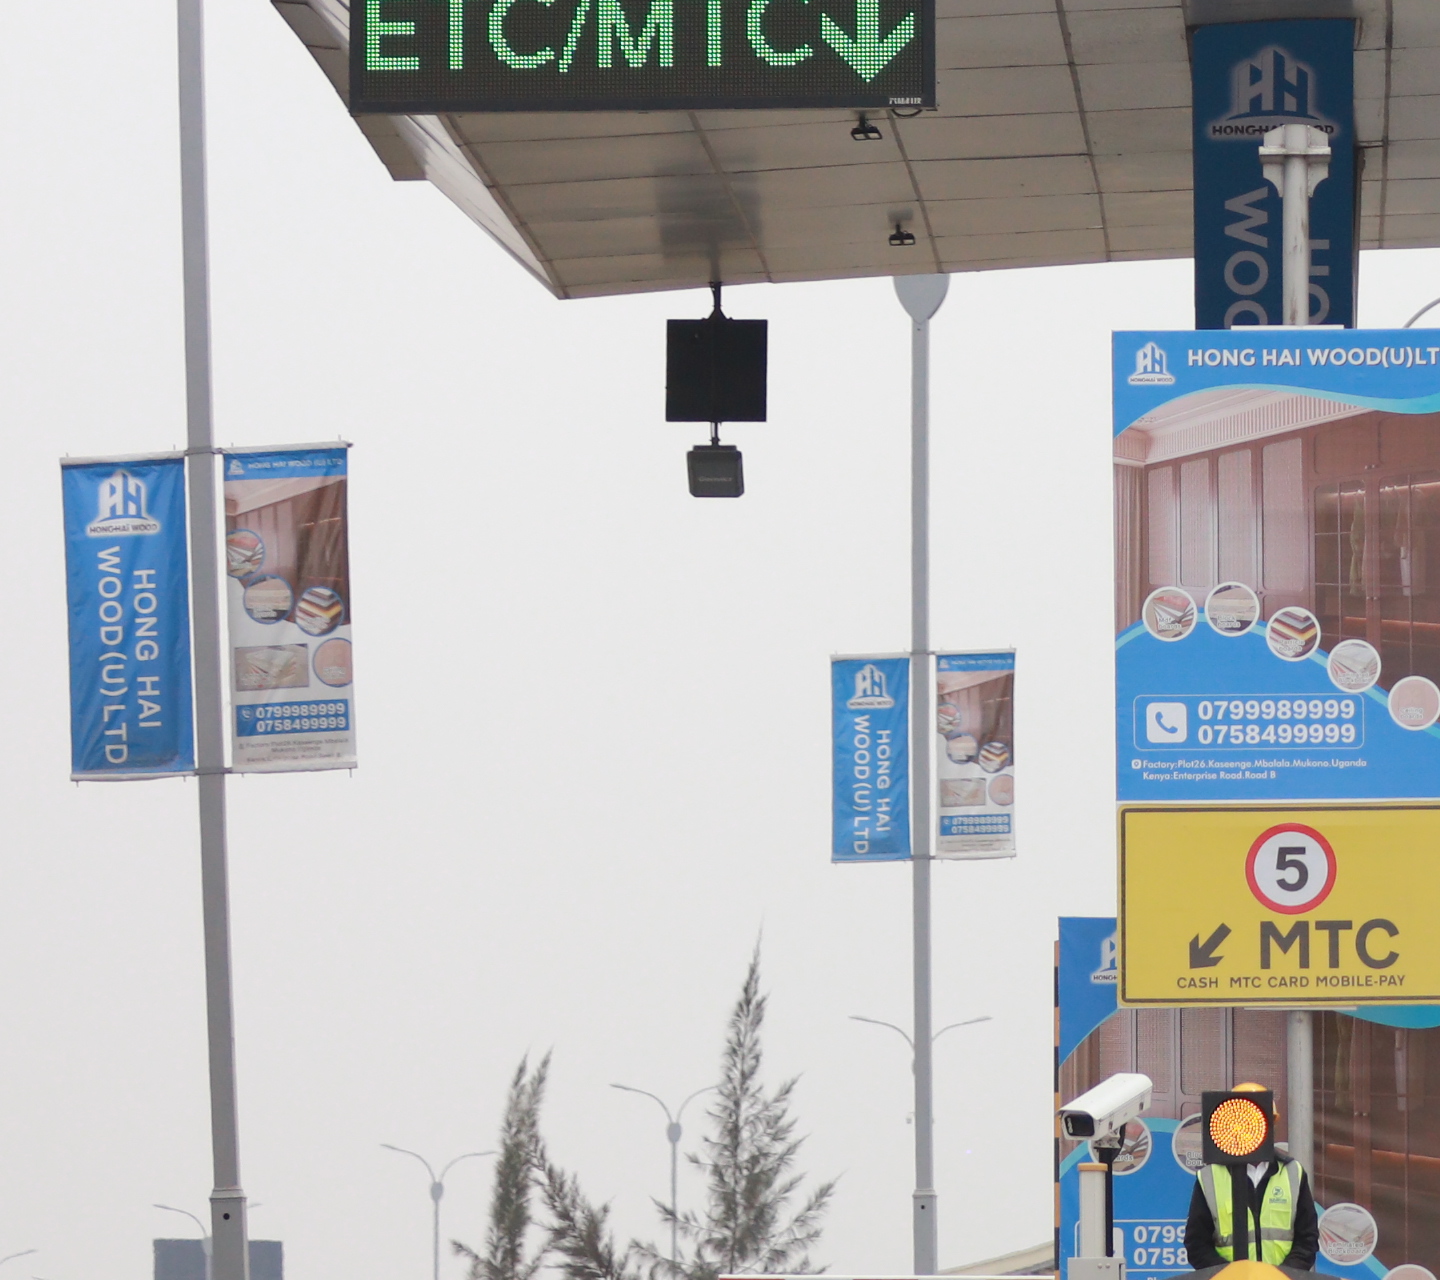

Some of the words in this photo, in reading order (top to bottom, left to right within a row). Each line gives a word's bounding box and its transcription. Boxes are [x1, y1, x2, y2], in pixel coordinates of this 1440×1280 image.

[1187, 349, 1256, 367] HONG
[1262, 349, 1300, 367] HAI
[133, 569, 160, 662] HONG
[97, 545, 129, 764] WOOD(U)LTD
[137, 675, 162, 728] HAI
[255, 702, 346, 719] 0799989999
[1197, 700, 1356, 720] 0799989999
[256, 717, 347, 733] 0758499999
[1197, 724, 1356, 745] 0758499999
[876, 730, 892, 789] HONG
[1269, 770, 1276, 779] B
[876, 798, 892, 831] HAI
[1275, 846, 1309, 892] 5
[1260, 919, 1401, 969] MTC
[1176, 977, 1218, 989] CASH
[1229, 976, 1262, 988] MTC
[1267, 976, 1309, 988] CARD
[1315, 975, 1406, 987] MOBILE-PAY
